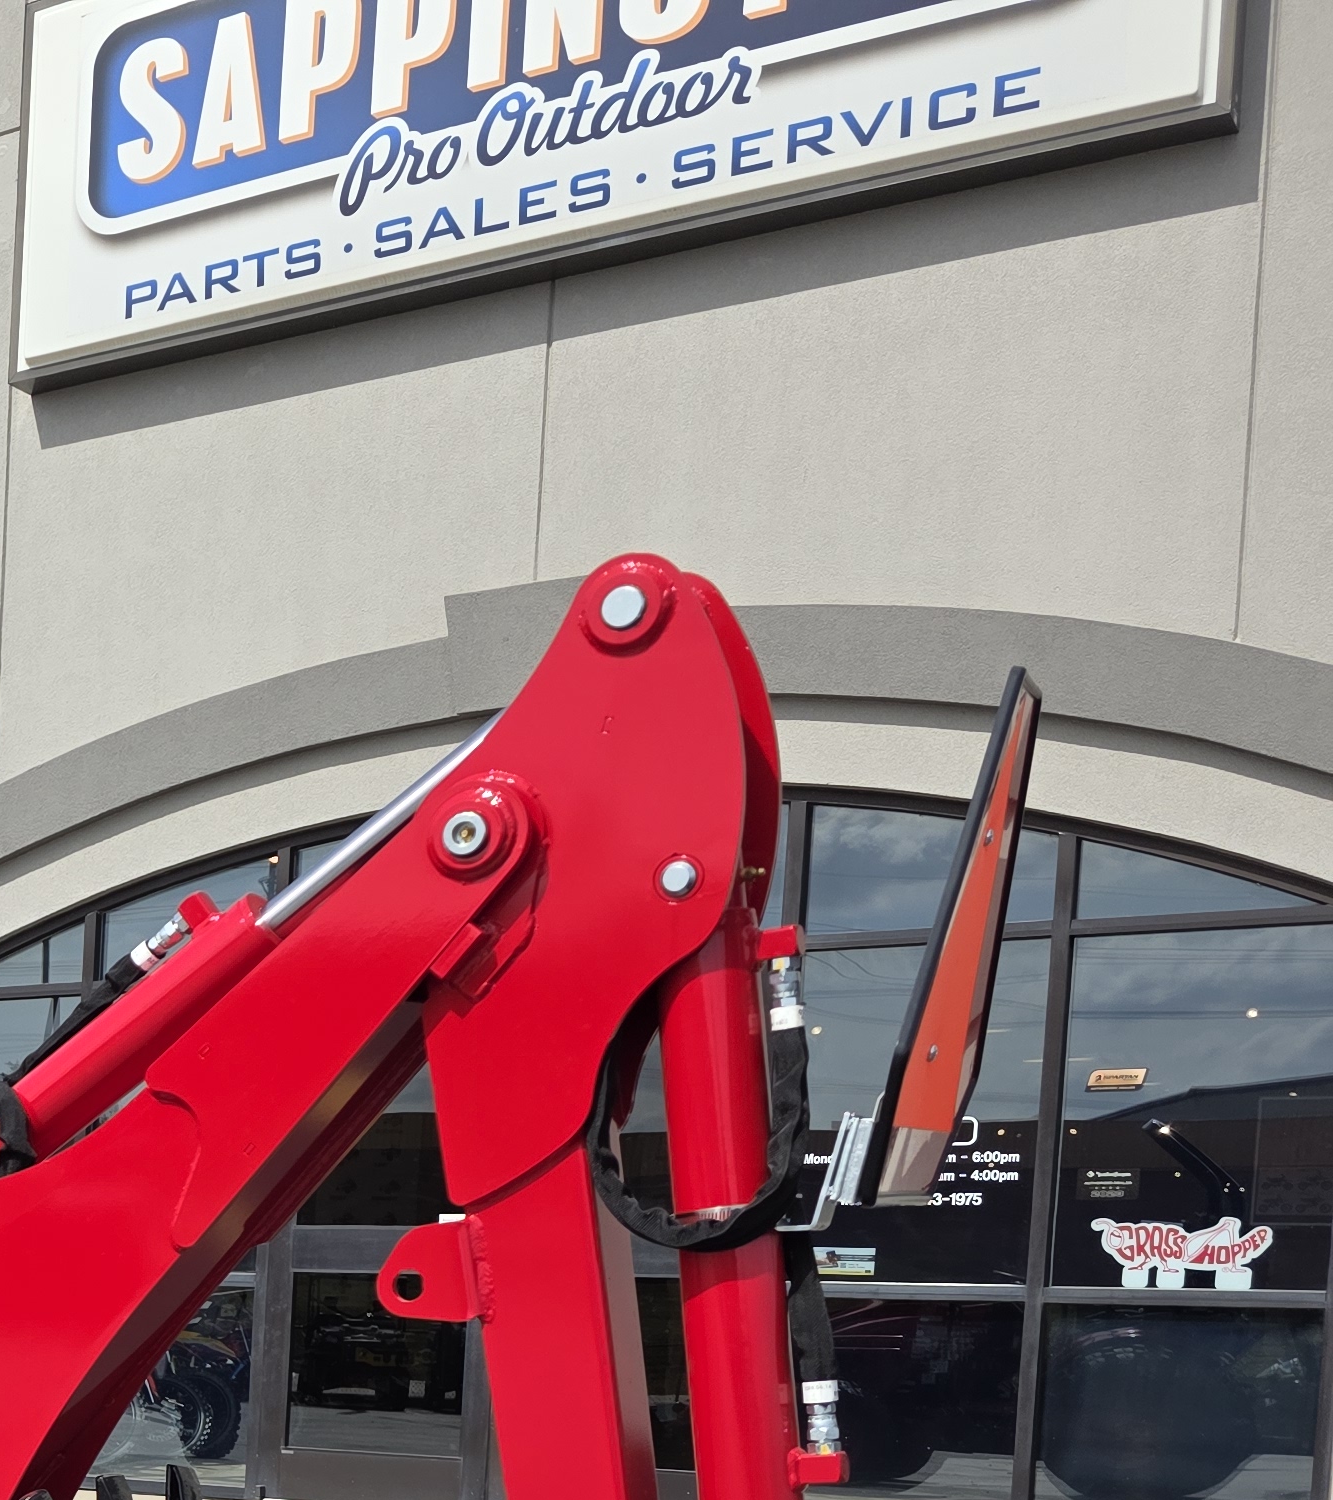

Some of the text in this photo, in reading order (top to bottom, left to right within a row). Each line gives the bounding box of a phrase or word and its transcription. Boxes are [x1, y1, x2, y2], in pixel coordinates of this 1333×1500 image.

[338, 56, 753, 217] Pro Outdoor
[124, 66, 1042, 320] PARTS SALES SERVICE
[970, 1170, 1019, 1183] 4:00pm
[972, 1151, 1020, 1164] 6:00pm
